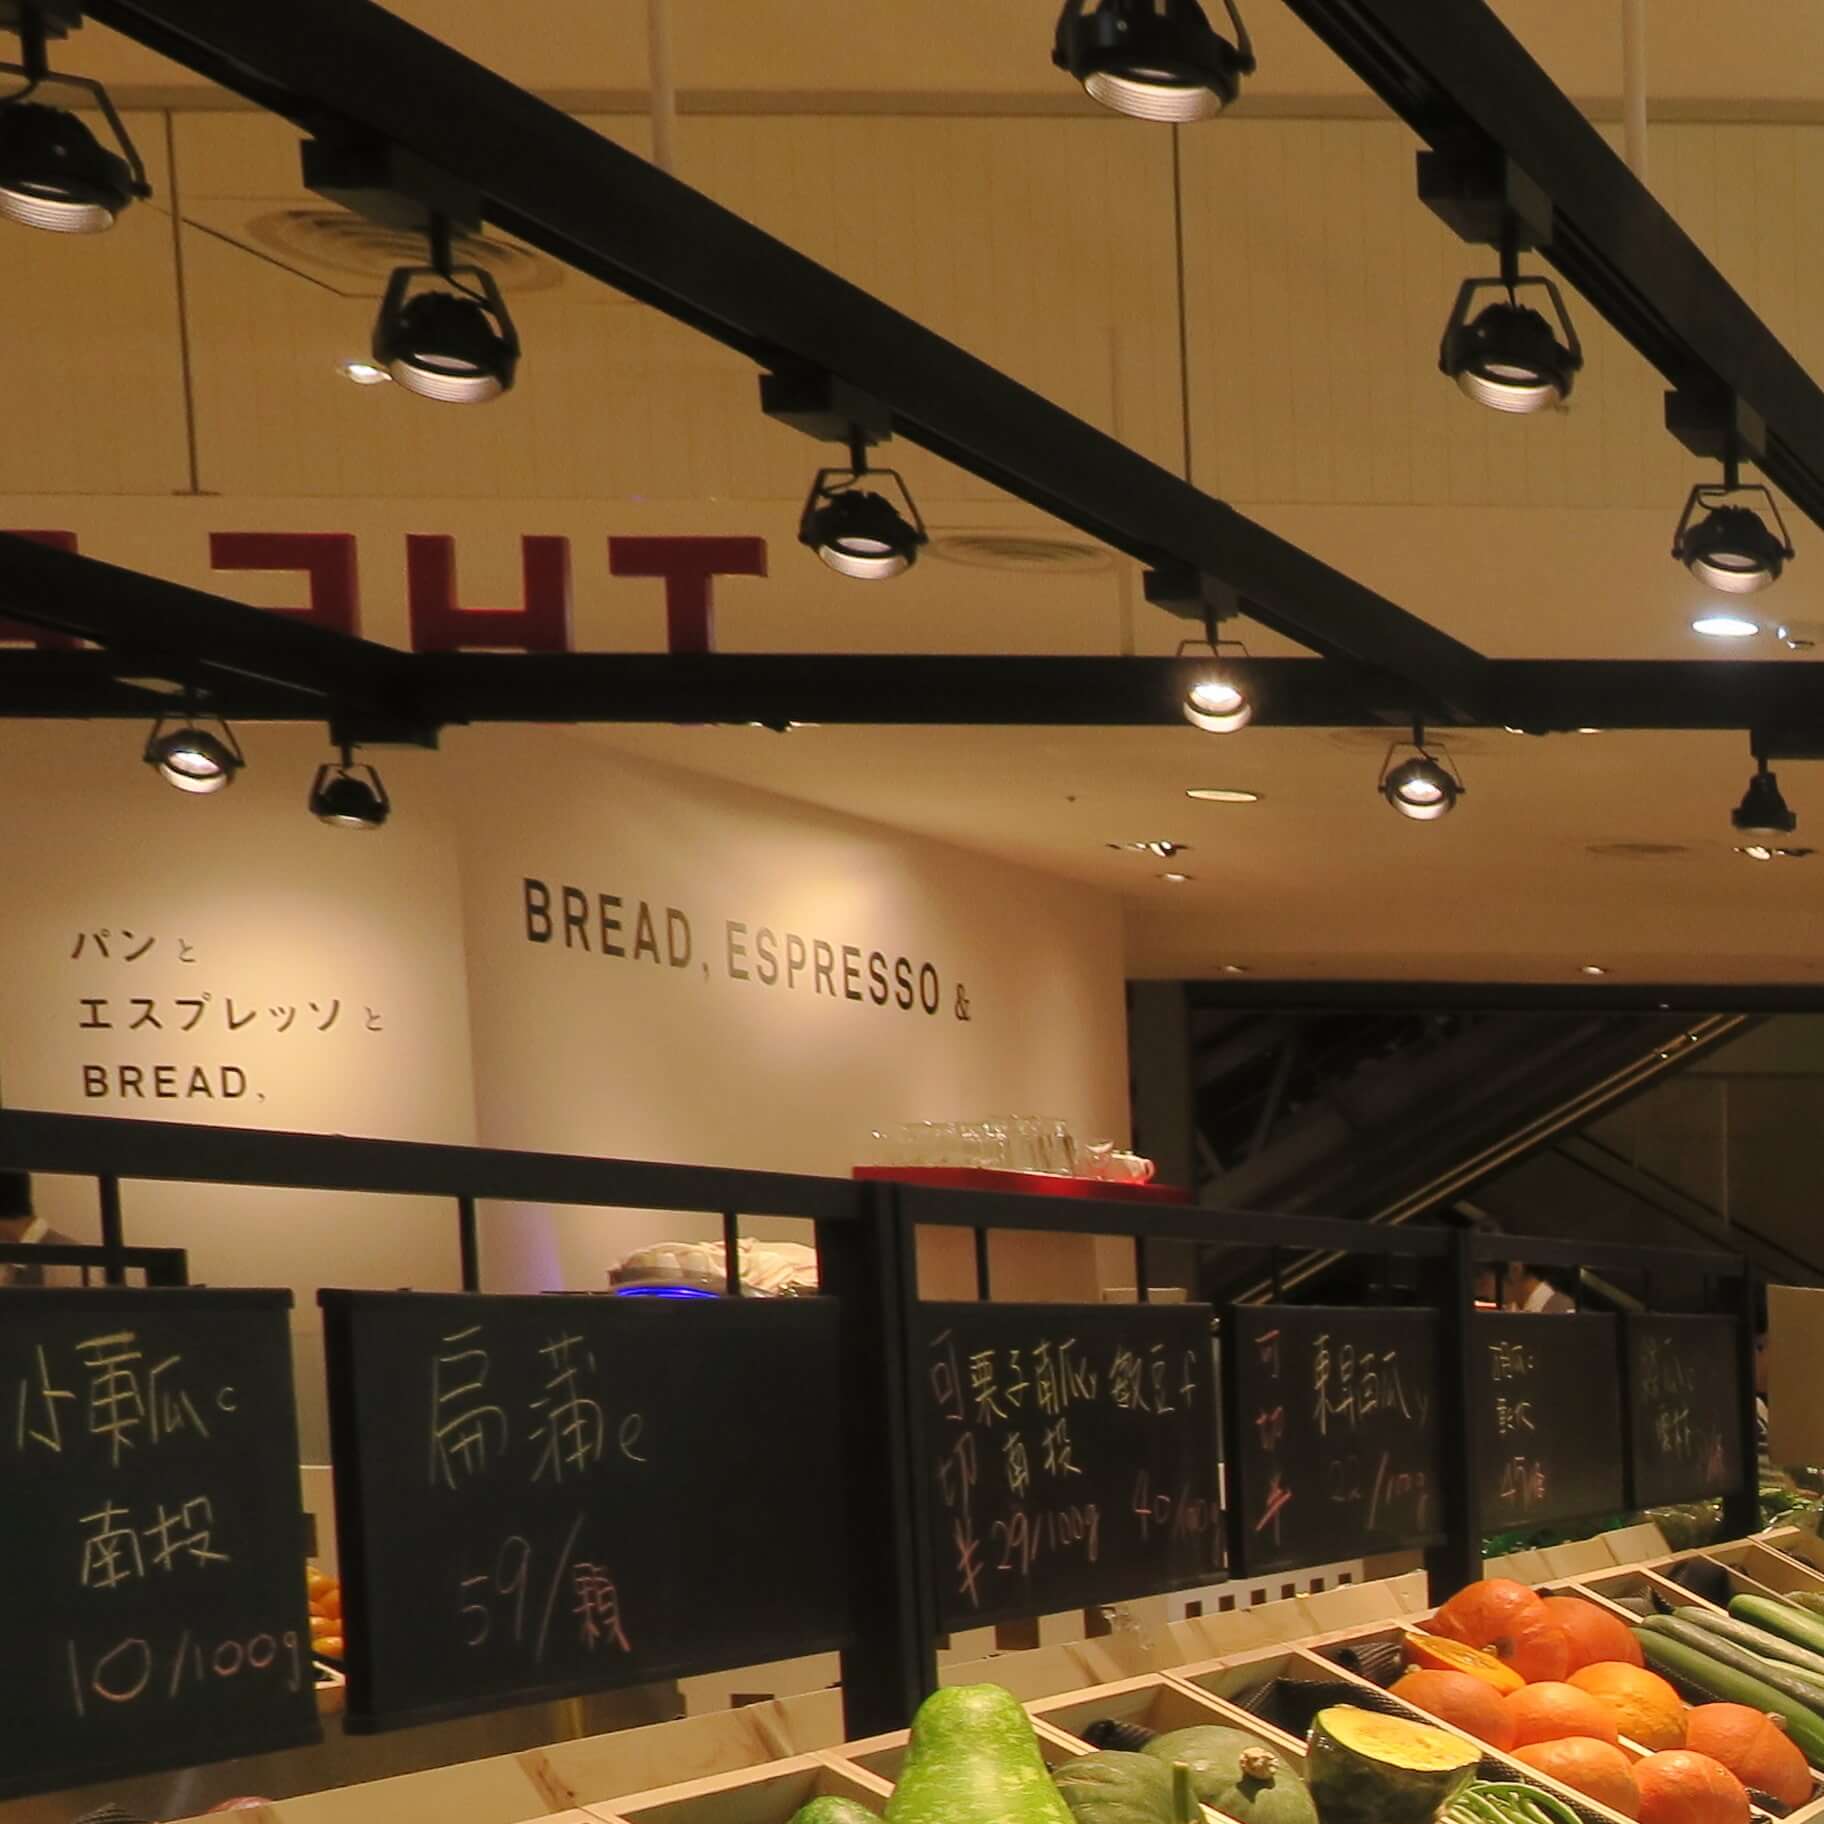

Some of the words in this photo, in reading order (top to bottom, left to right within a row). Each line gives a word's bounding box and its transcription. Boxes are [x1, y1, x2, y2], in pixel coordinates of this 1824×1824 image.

[523, 877, 711, 982] BREAD,
[726, 919, 940, 1015] ESPRESSO
[954, 983, 971, 1021] &
[82, 1065, 266, 1103] BREAD,
[78, 1495, 230, 1588] 南投
